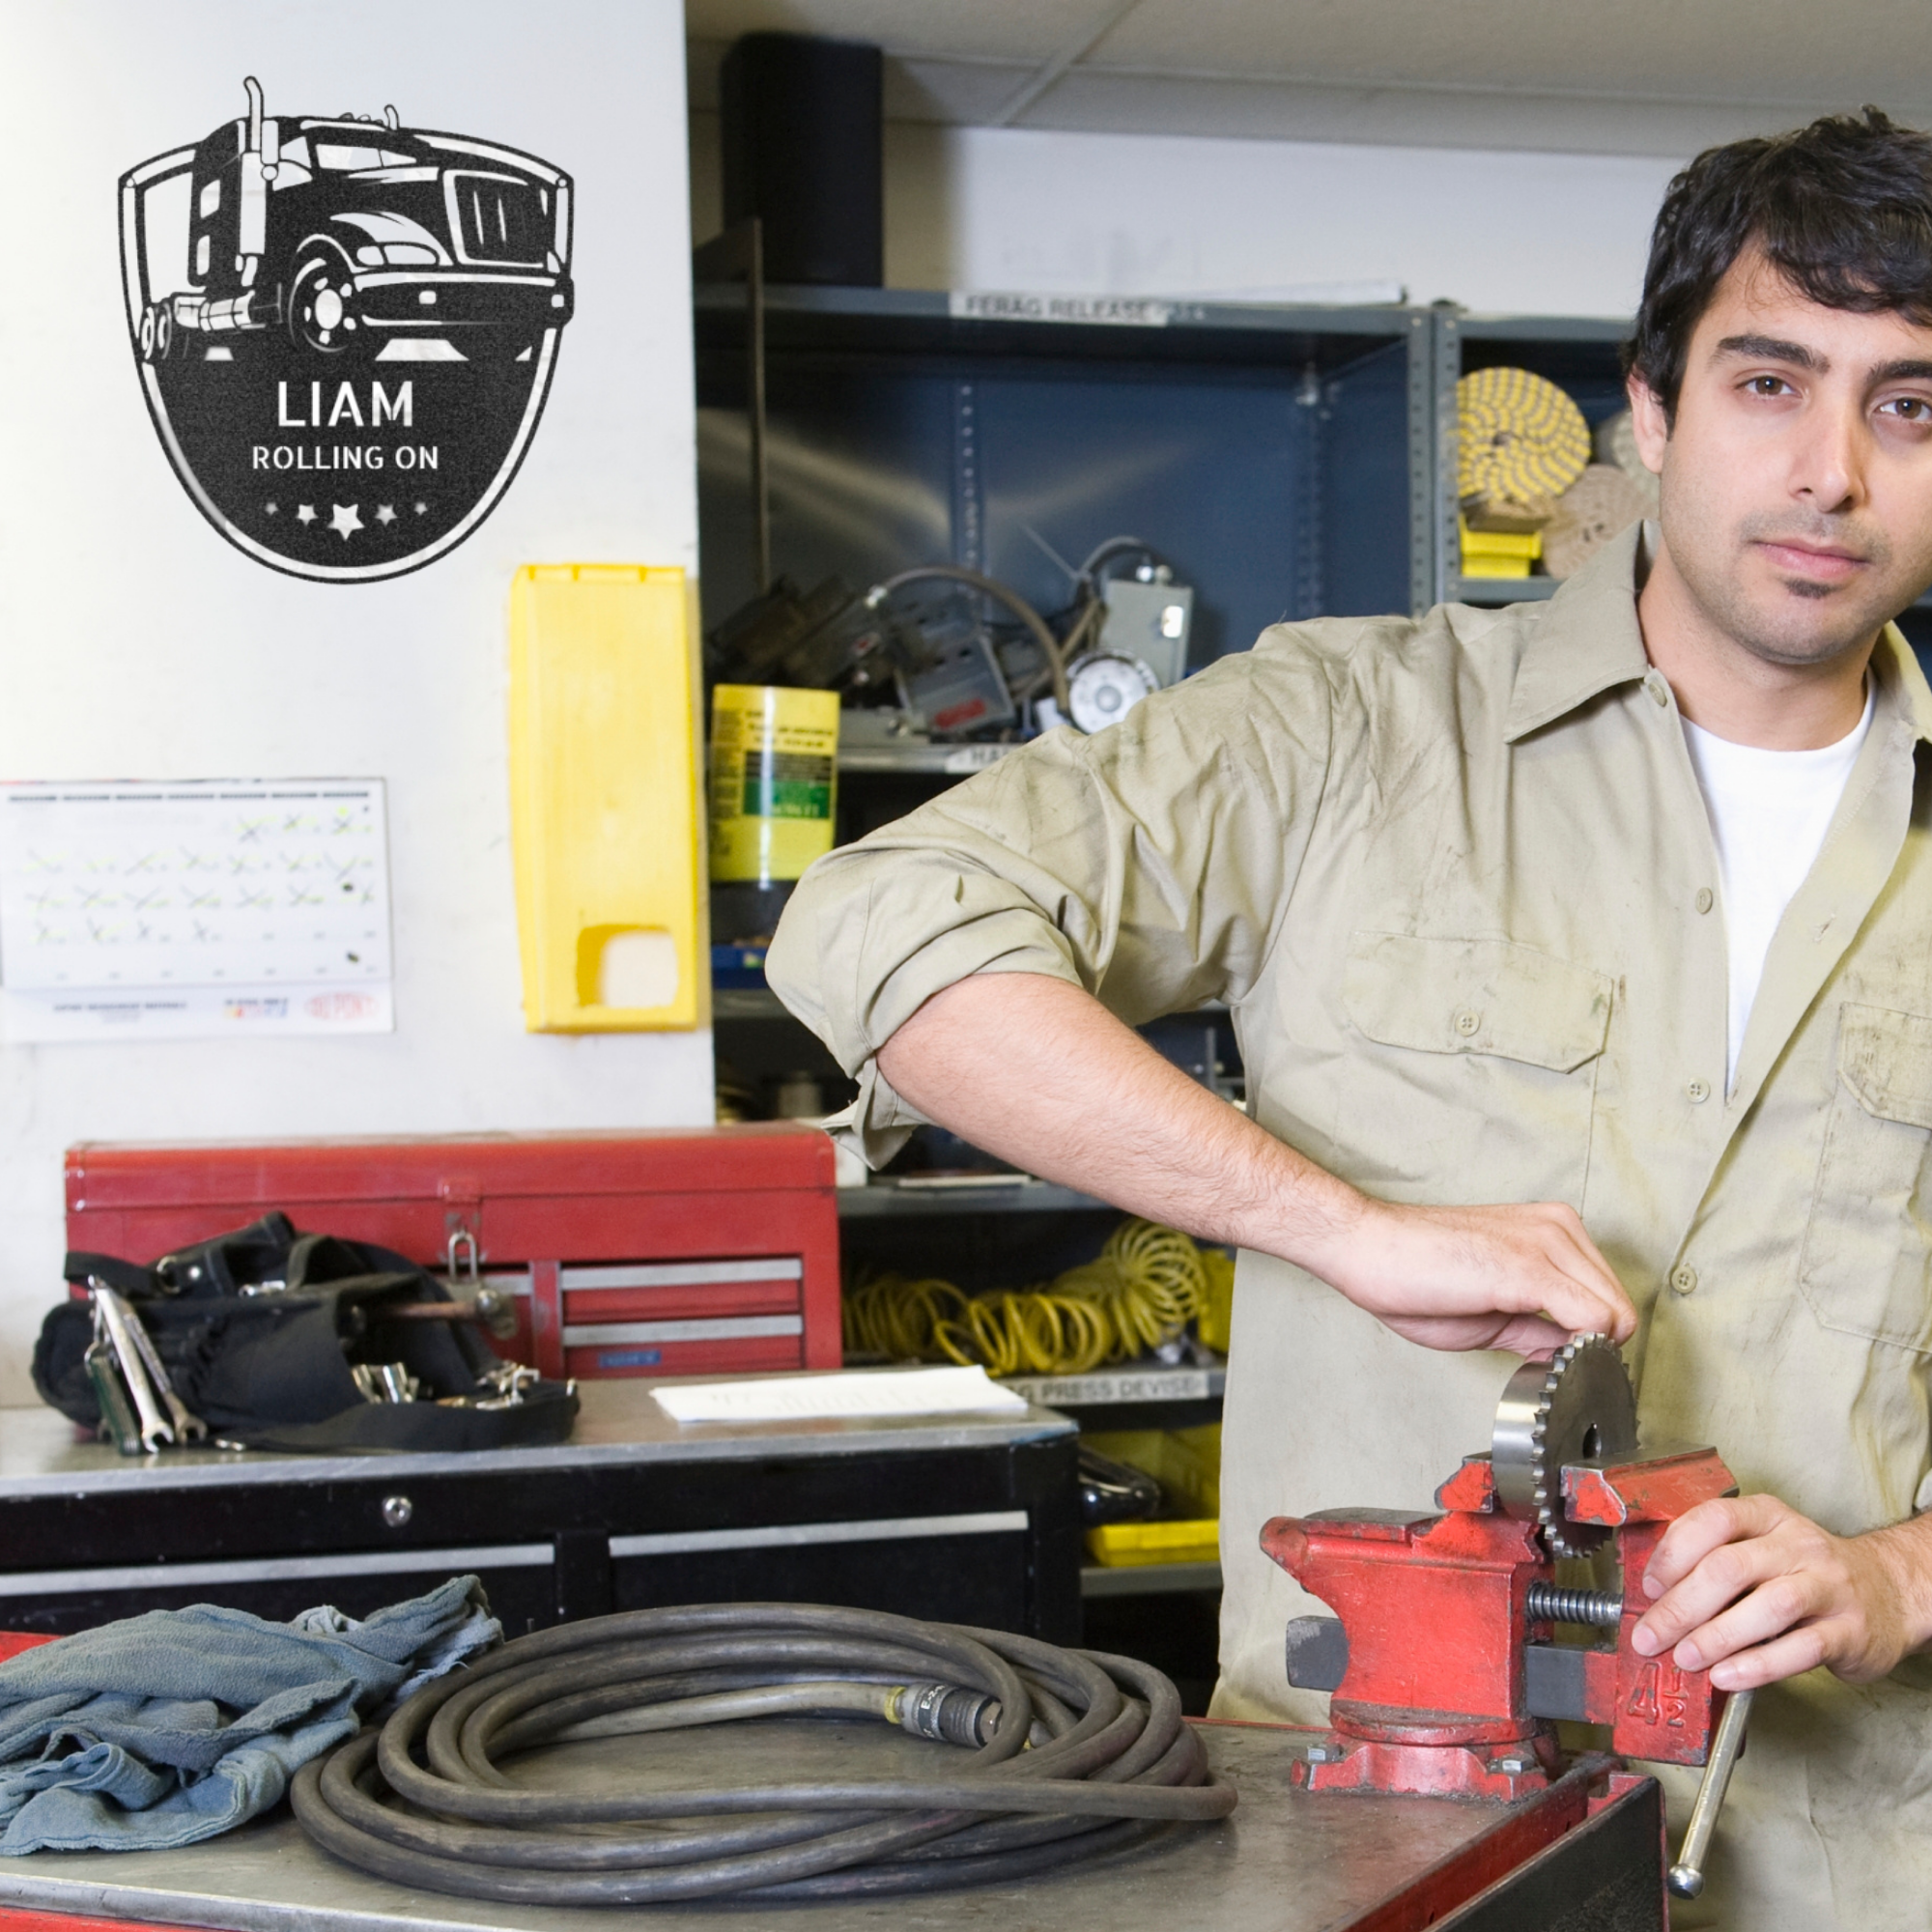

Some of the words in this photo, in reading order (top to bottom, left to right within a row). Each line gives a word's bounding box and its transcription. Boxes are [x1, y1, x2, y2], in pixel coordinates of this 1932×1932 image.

[1049, 298, 1151, 323] RELEASE
[278, 381, 413, 427] LIAM
[252, 445, 384, 469] ROLLING
[394, 445, 439, 469] ON
[1041, 1378, 1114, 1399] PRESS
